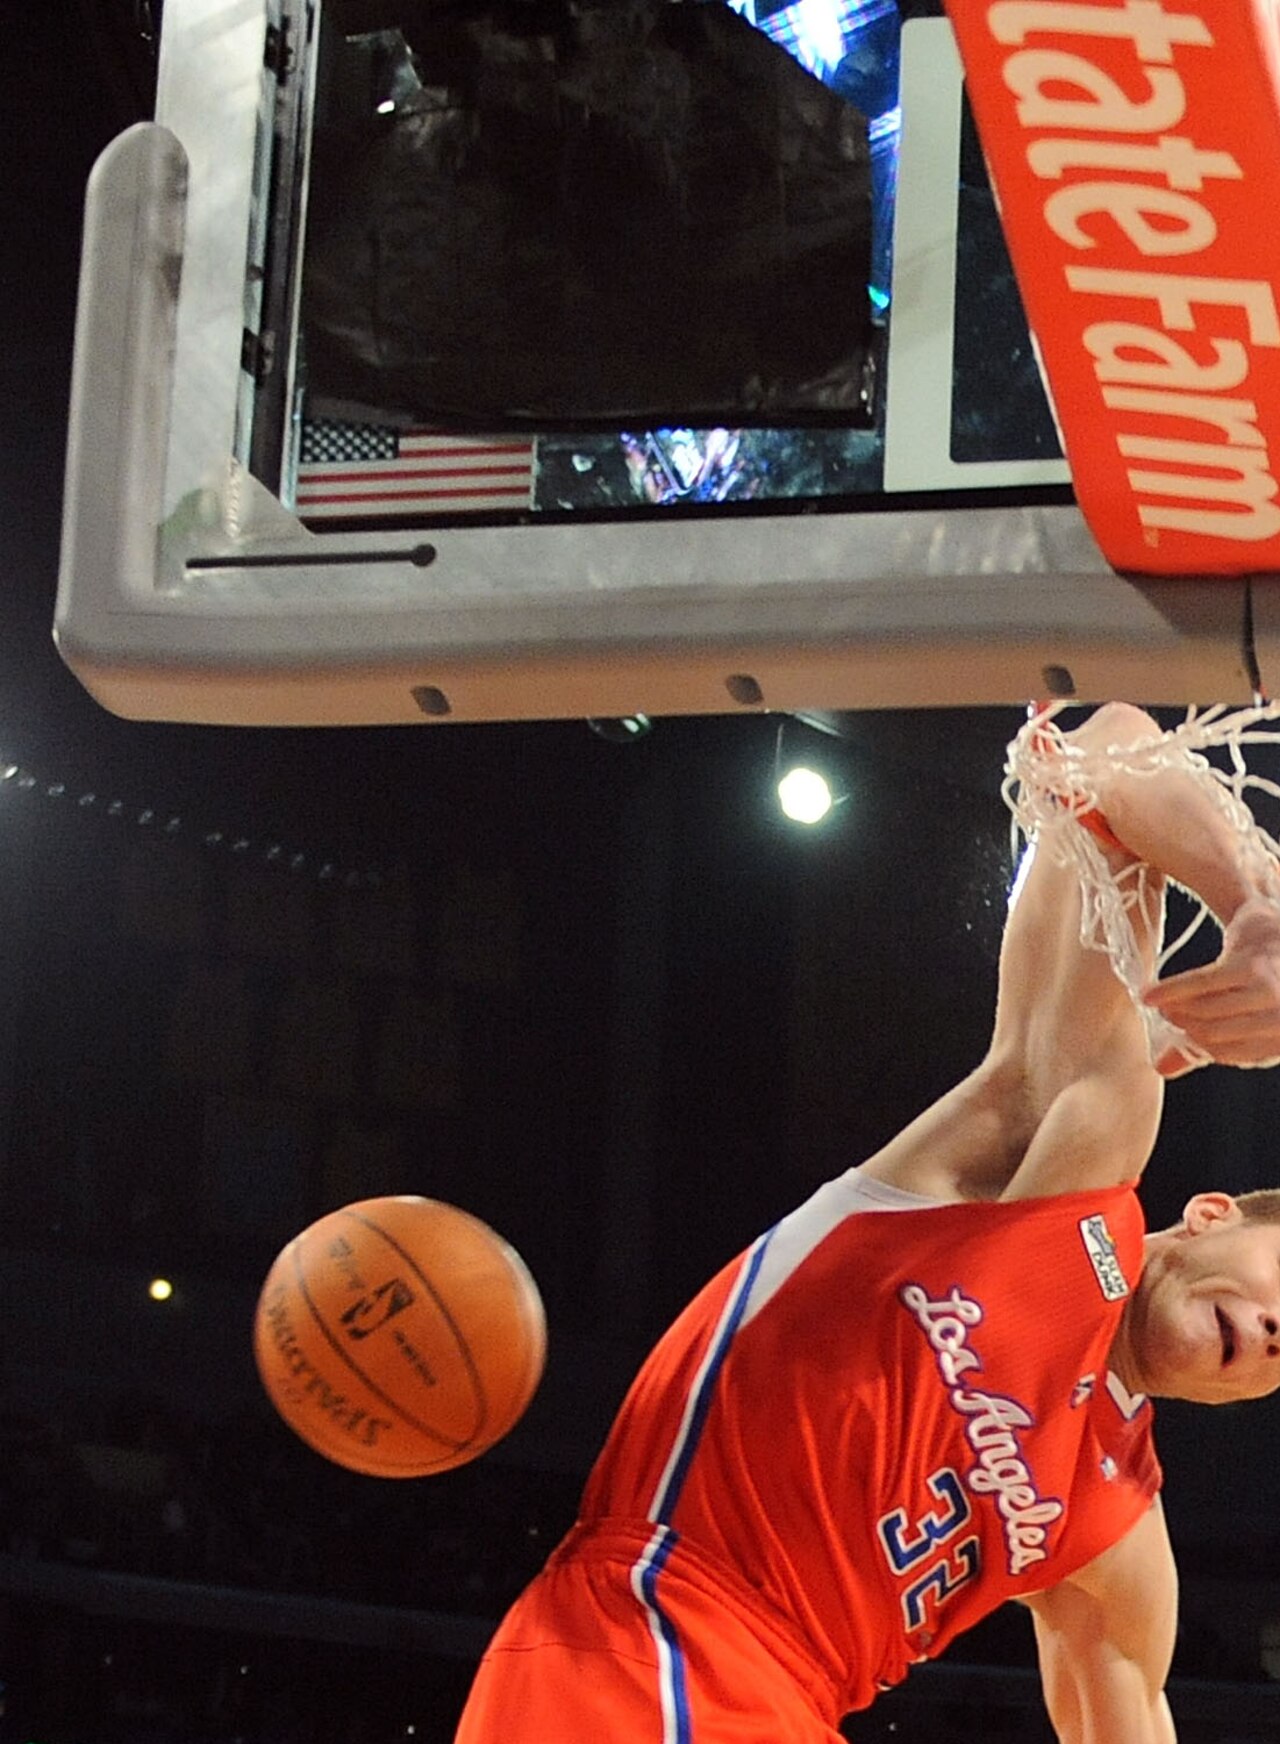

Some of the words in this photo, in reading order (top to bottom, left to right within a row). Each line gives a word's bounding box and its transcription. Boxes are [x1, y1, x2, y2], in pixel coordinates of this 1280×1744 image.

[901, 1283, 984, 1386] Los
[950, 1386, 1064, 1576] Angeles
[877, 1467, 981, 1633] 32
